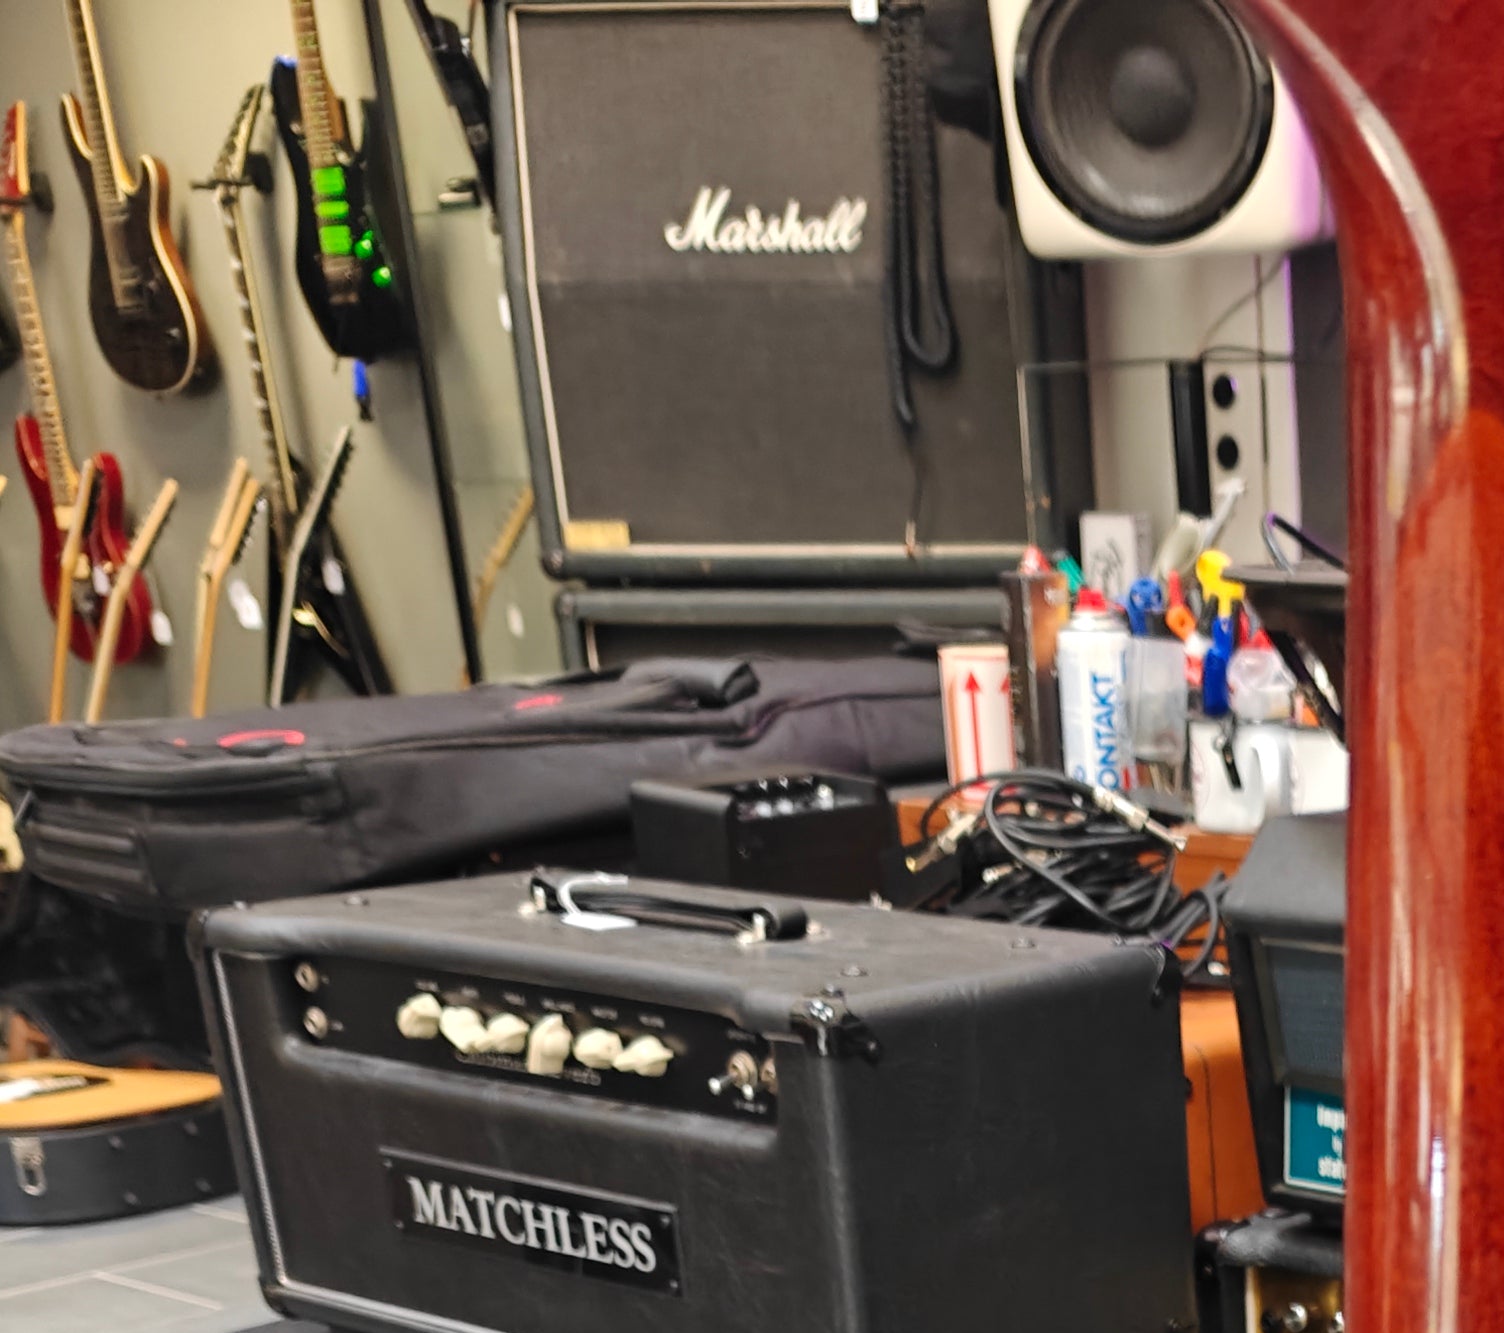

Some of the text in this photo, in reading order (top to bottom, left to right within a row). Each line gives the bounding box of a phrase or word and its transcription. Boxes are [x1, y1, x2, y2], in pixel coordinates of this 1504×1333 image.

[664, 185, 868, 253] Marshall
[1090, 672, 1119, 790] ONTAKT
[406, 1175, 657, 1273] MATCHLESS
